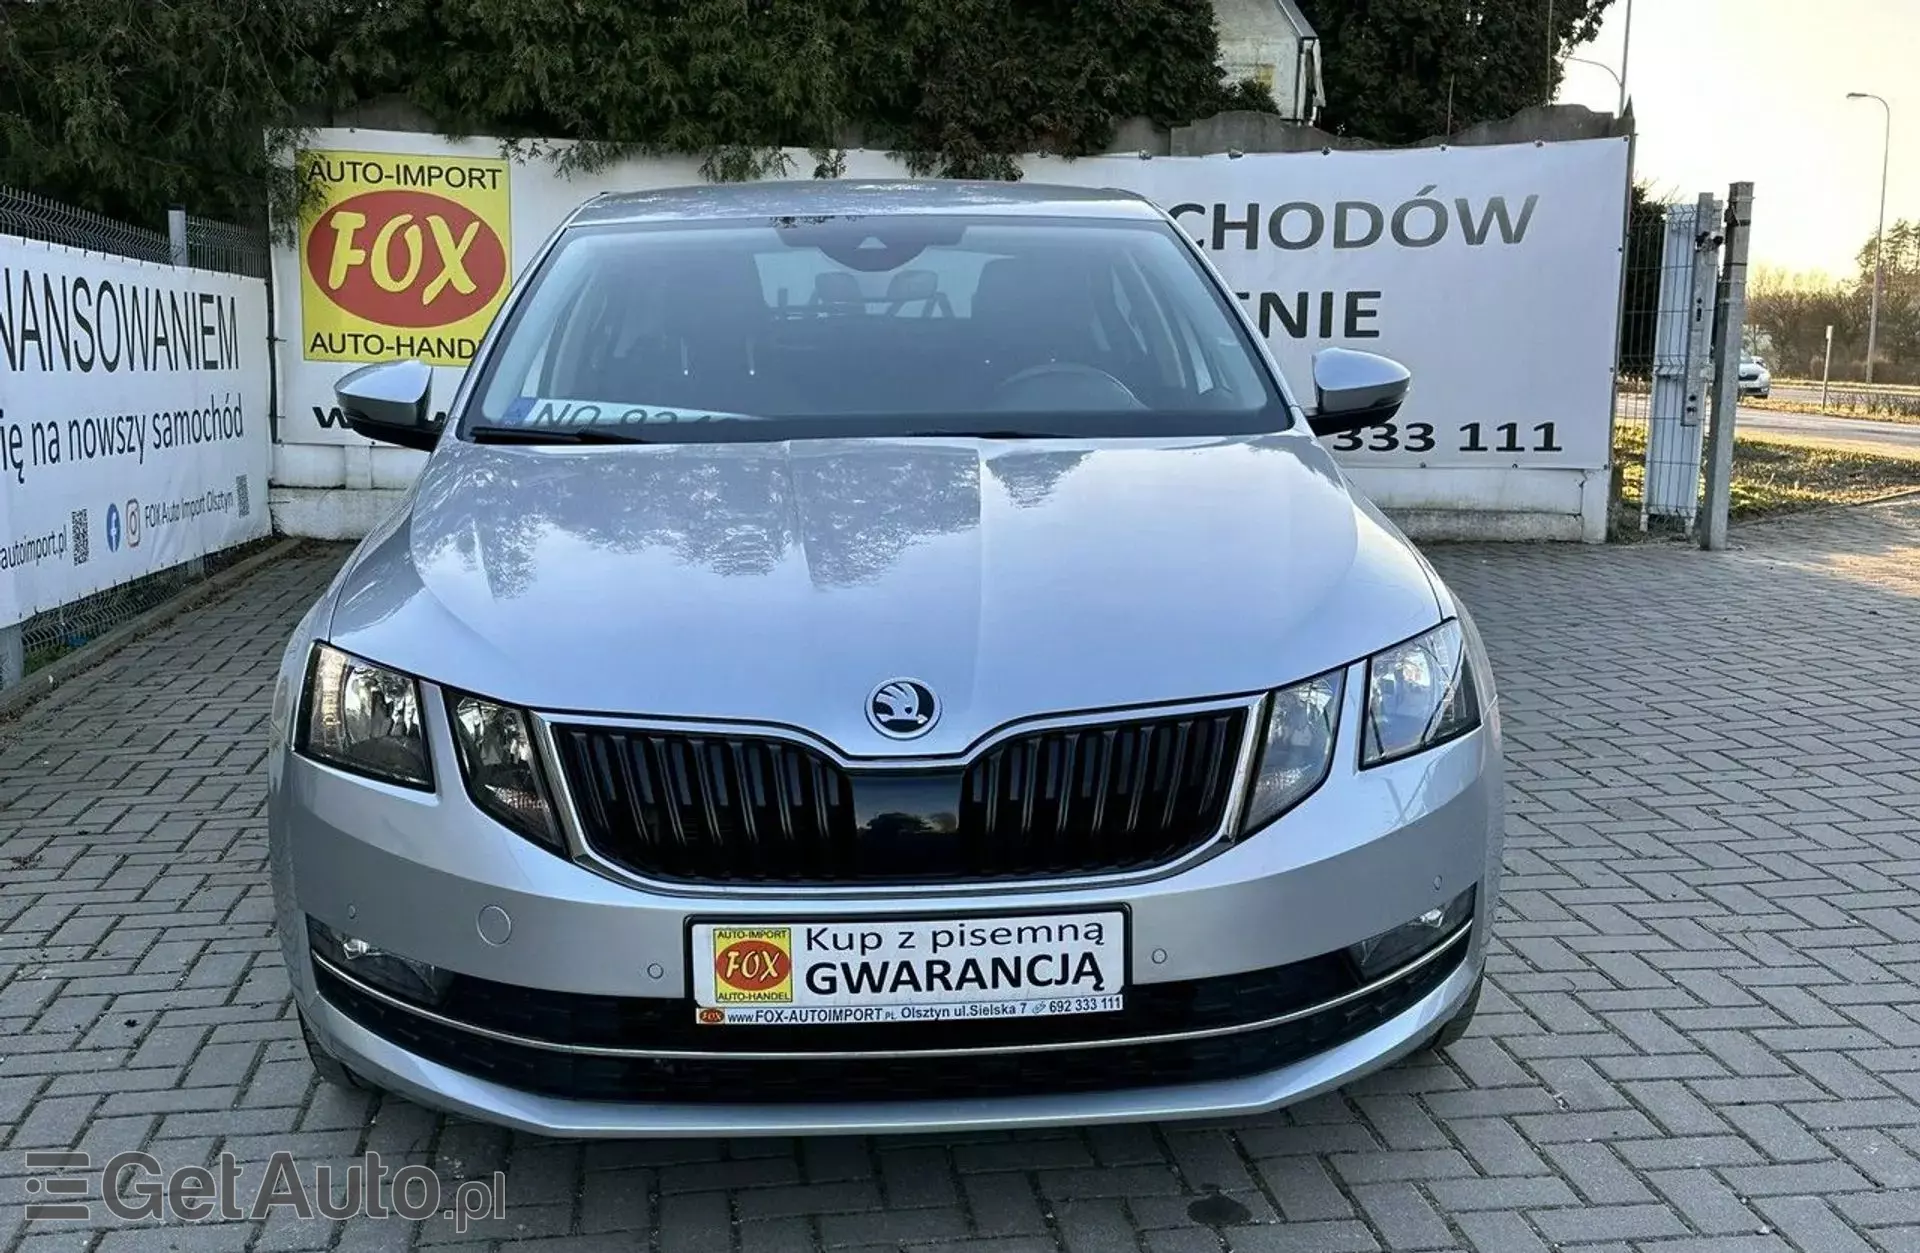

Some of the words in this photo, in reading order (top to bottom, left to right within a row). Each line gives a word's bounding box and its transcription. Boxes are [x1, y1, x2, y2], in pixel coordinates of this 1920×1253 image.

[308, 160, 502, 190] AUTO-IMPORT
[328, 211, 480, 305] FOX
[1235, 290, 1382, 339] NIE
[310, 332, 484, 359] AUTO-HAND
[32, 420, 60, 465] na
[69, 413, 146, 465] nowszy
[153, 393, 244, 450] samochód
[1333, 422, 1436, 452] 333
[1459, 422, 1563, 452] 111
[145, 503, 160, 528] FOX
[162, 501, 180, 524] Auto
[717, 930, 787, 939] AUTO-IMPORT
[806, 927, 883, 956] Kup
[898, 931, 916, 949] z
[932, 922, 1104, 953] pisemną
[726, 950, 780, 982] FOX
[805, 951, 1105, 995] GWARANCJĄ
[718, 991, 790, 1001] AUTO-HANDEL
[901, 1006, 950, 1021] Olsztyn
[954, 1003, 1016, 1018] ul.Sielska
[1020, 1002, 1027, 1014] 7
[1049, 1000, 1071, 1013] 692
[1075, 998, 1098, 1011] 333
[1102, 996, 1122, 1009] 111
